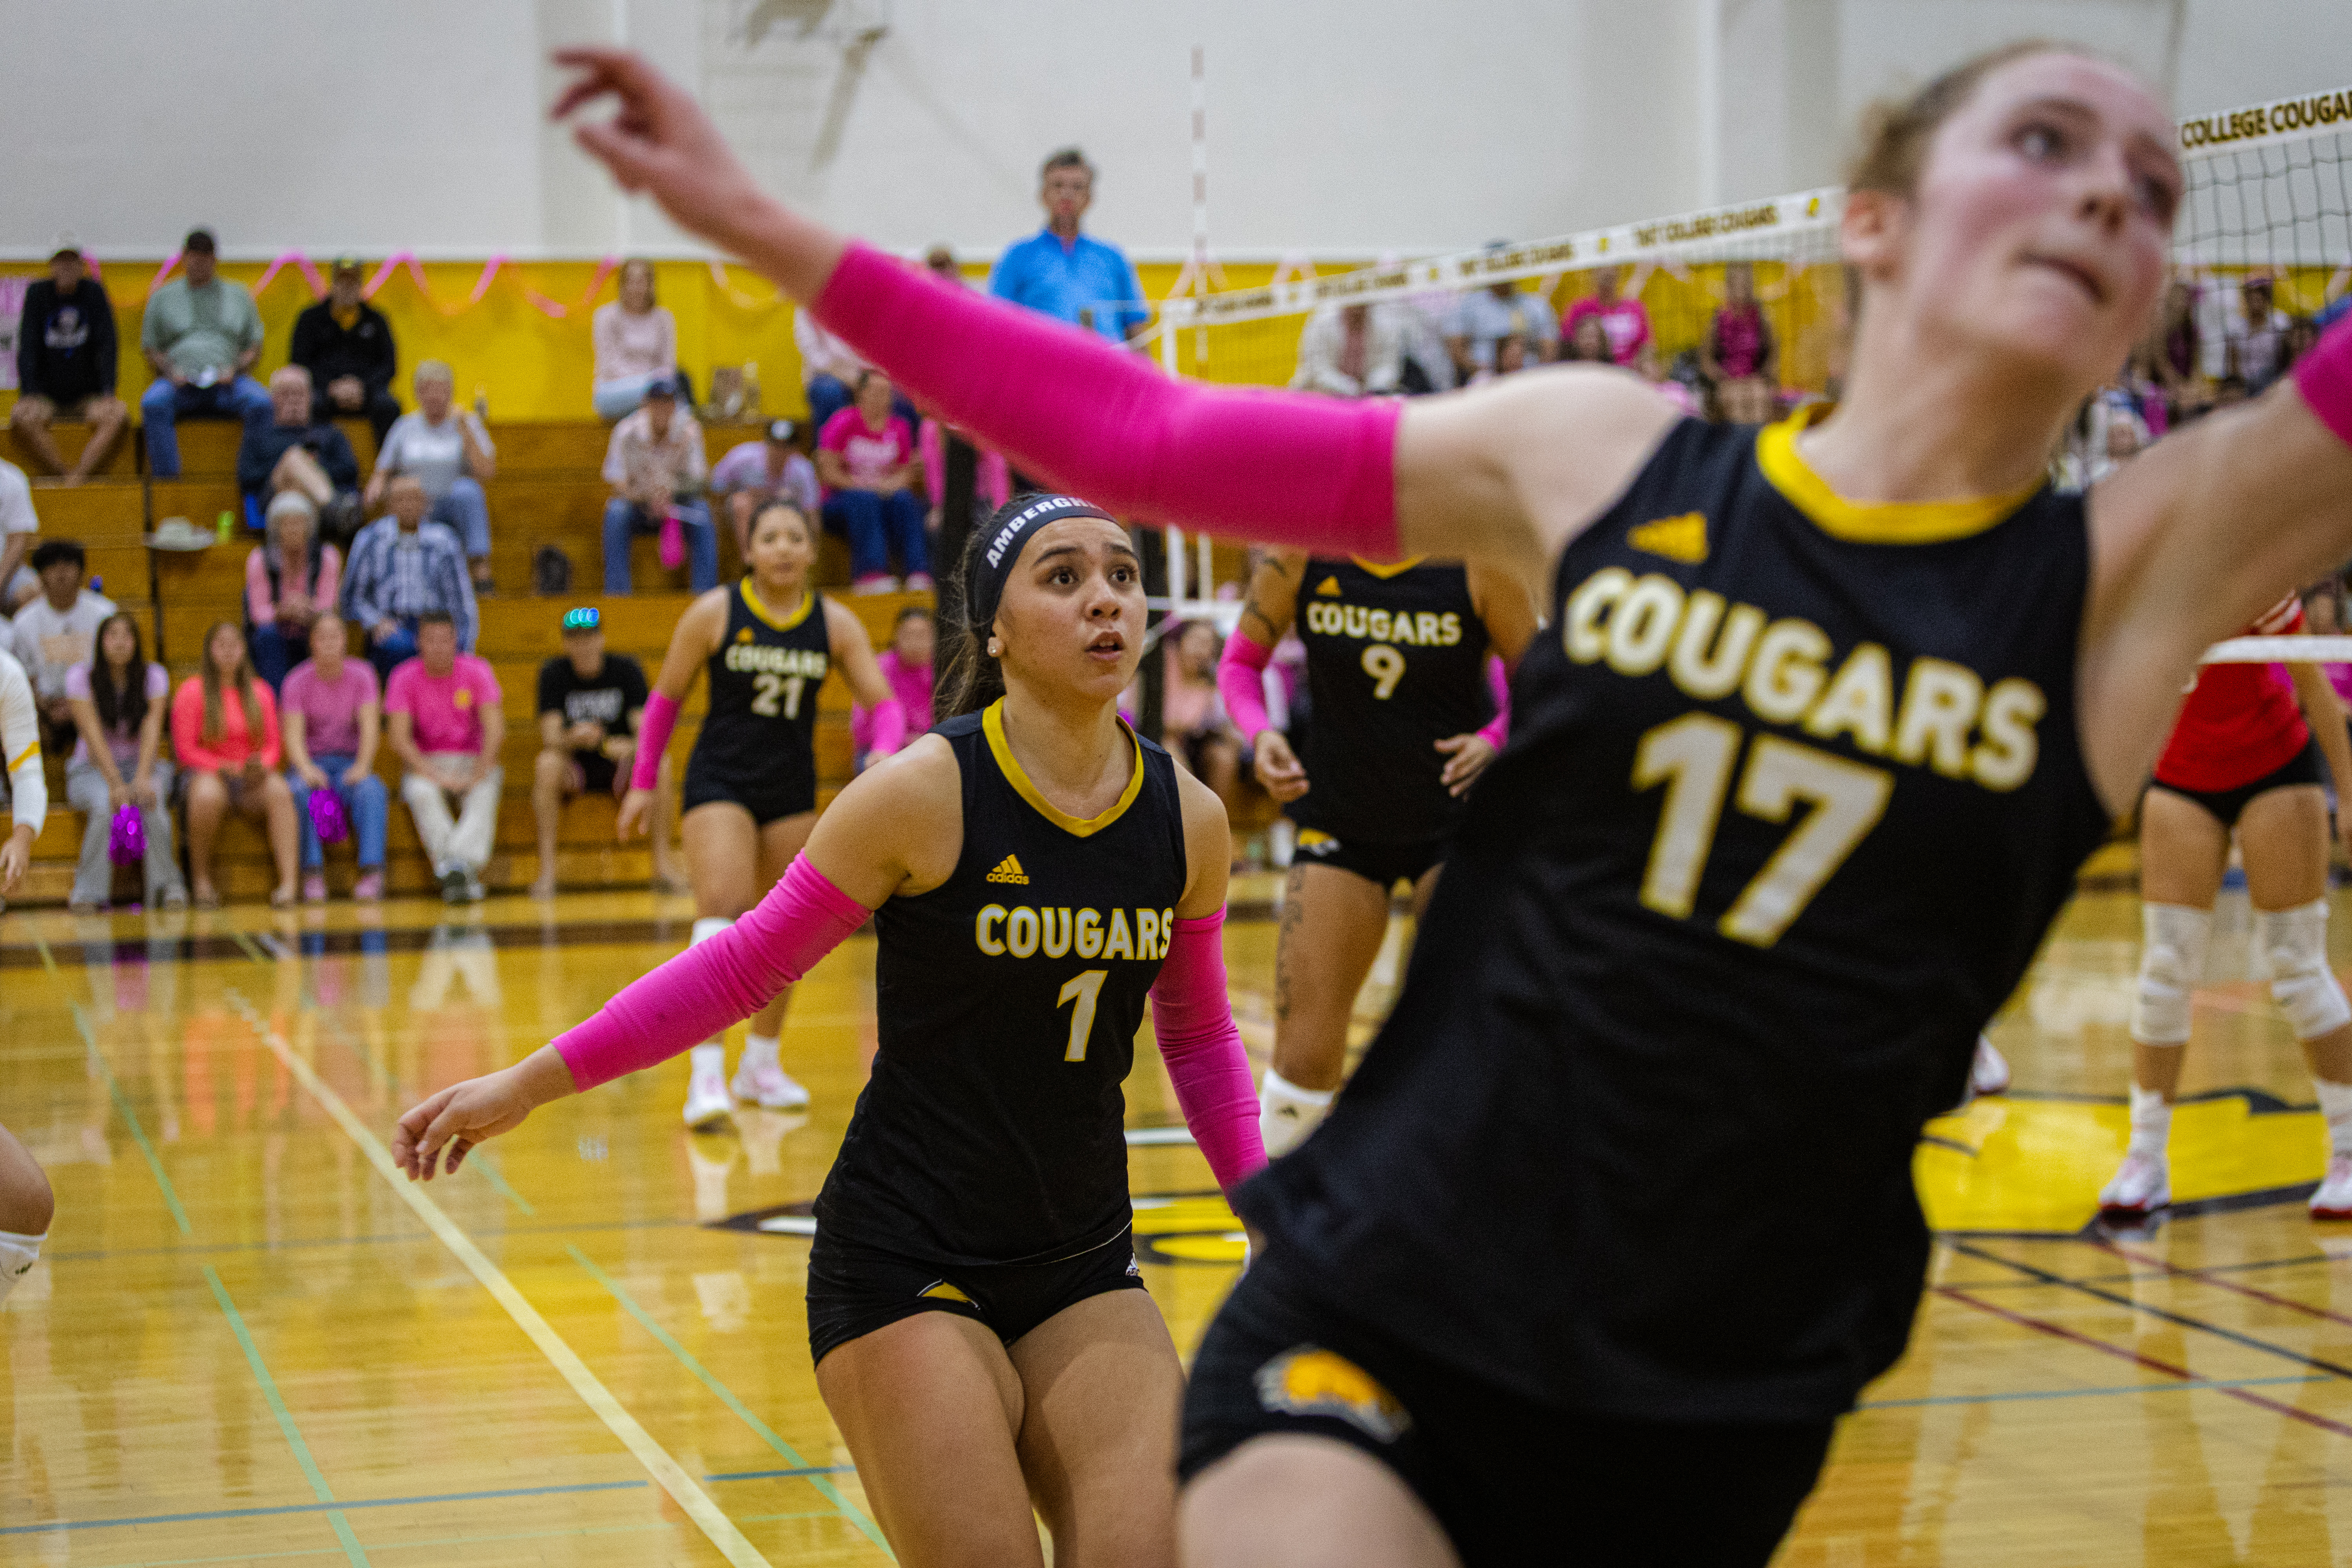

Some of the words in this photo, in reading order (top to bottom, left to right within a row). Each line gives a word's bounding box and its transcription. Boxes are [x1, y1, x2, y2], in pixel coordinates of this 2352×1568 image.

[2182, 107, 2268, 149] COLLEGE
[1306, 601, 1463, 647] COUGARS
[725, 644, 827, 679] COUGARS
[1360, 644, 1407, 700] 9
[1563, 565, 2048, 793] COUGARS
[751, 673, 806, 720] 21
[1630, 710, 1896, 949] 17
[986, 873, 1029, 885] adidas
[976, 904, 1174, 960] COUGARS
[1057, 969, 1109, 1062] 1
